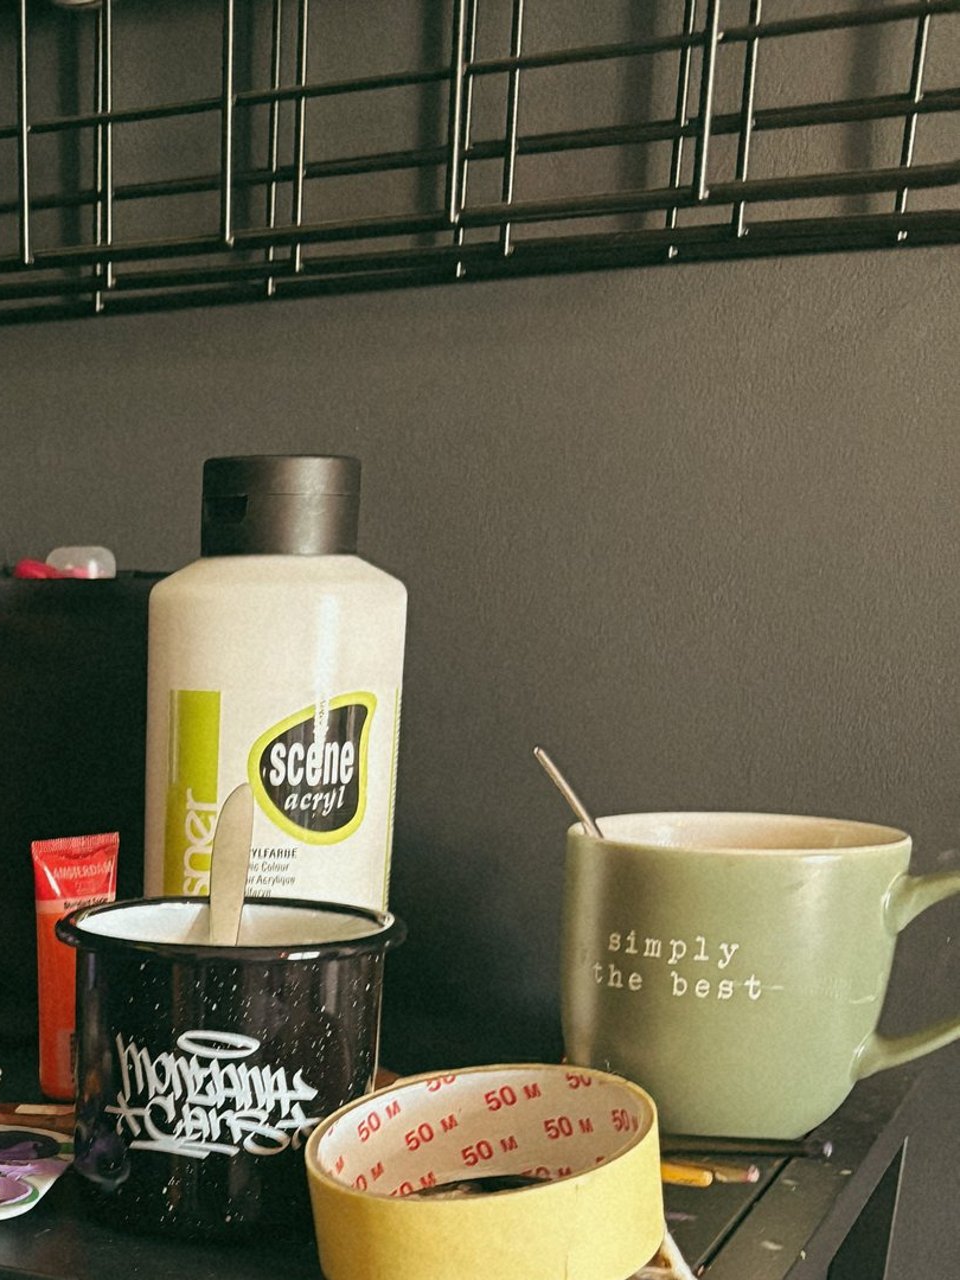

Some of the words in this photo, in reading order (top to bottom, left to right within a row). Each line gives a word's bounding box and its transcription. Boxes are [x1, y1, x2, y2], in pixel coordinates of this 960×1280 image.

[269, 740, 354, 787] scene
[284, 786, 347, 817] acryl
[608, 929, 740, 969] simply
[592, 962, 643, 991] the
[671, 971, 762, 1000] best
[484, 1085, 518, 1112] 50
[523, 1082, 542, 1100] M
[357, 1111, 381, 1142] 50
[385, 1100, 402, 1119] M
[404, 1122, 435, 1152] 50
[440, 1113, 459, 1133] M
[544, 1115, 573, 1140] 50
[578, 1117, 594, 1134] M
[460, 1139, 494, 1168] 50
[499, 1135, 519, 1153] M
